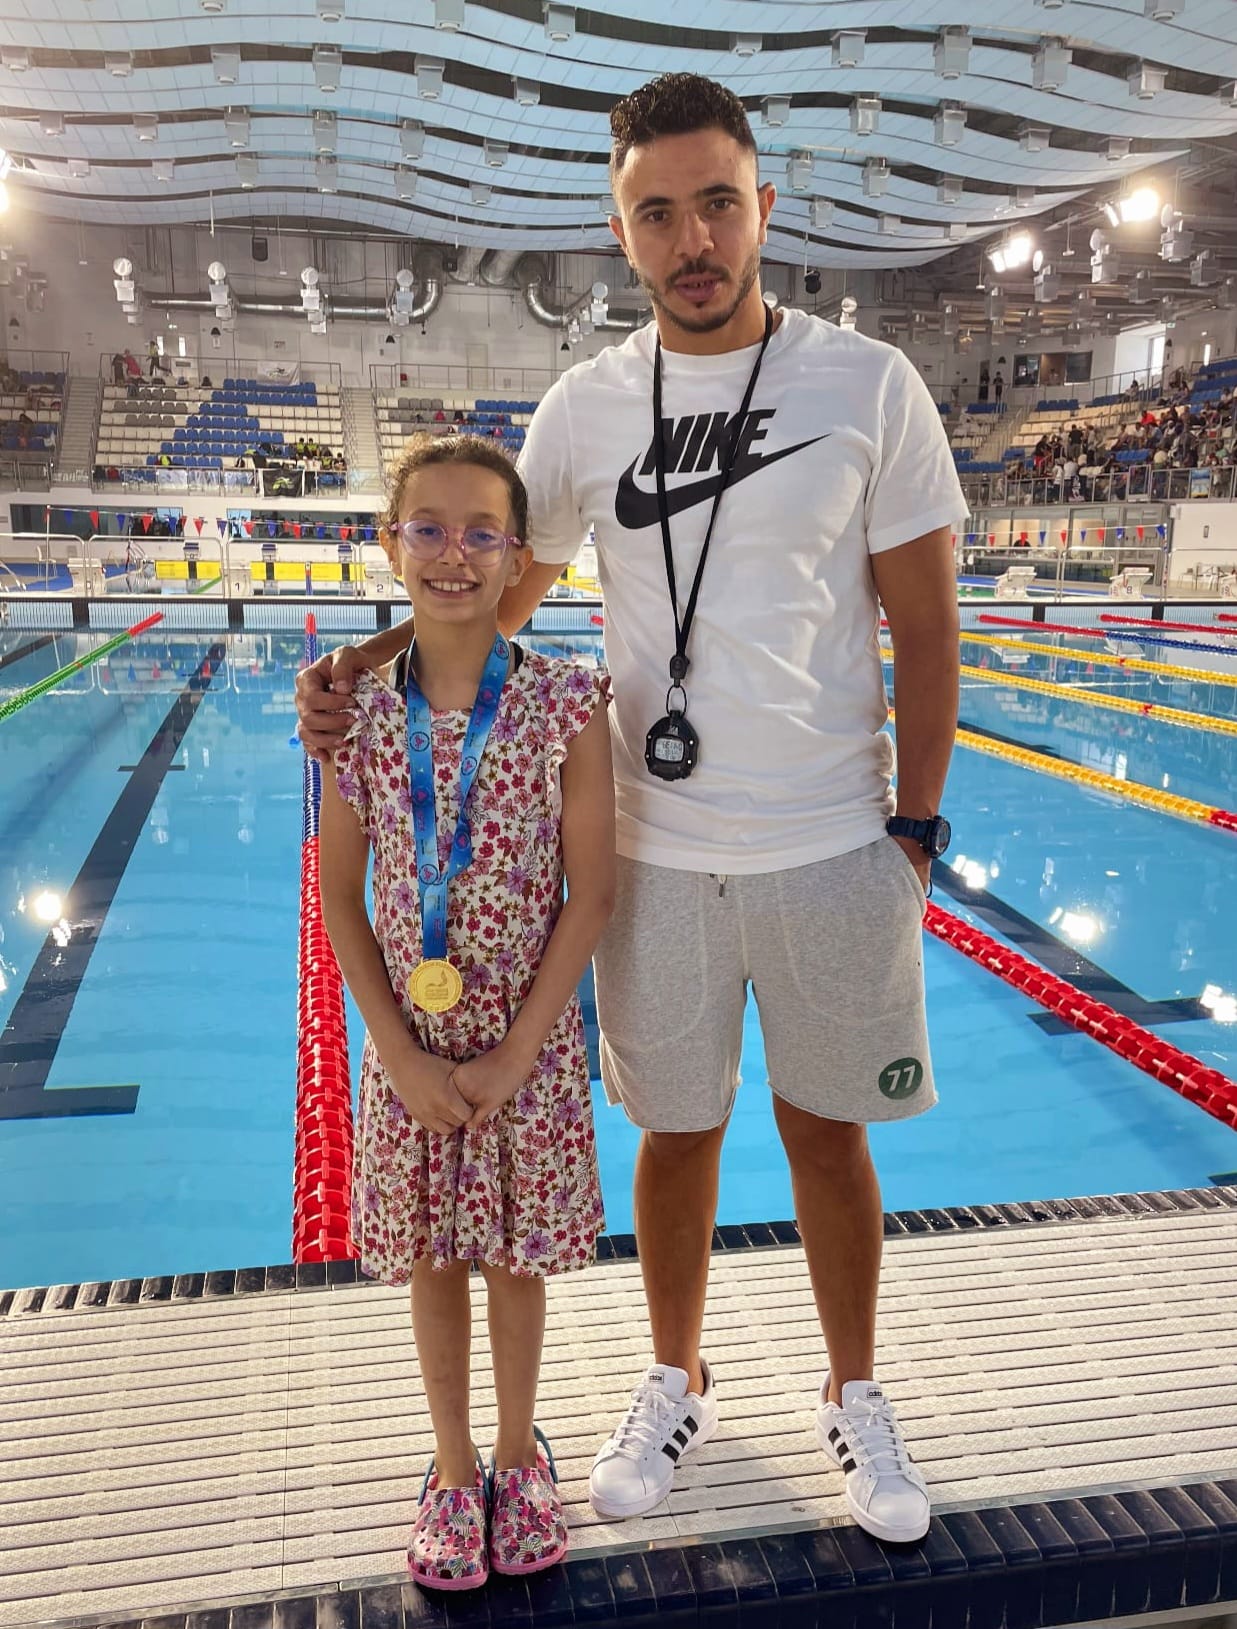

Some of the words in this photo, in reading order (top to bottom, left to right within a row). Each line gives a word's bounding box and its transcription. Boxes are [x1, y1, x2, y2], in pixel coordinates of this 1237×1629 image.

[638, 408, 777, 476] NIKE
[234, 582, 240, 591] 1
[376, 583, 384, 593] 2
[1126, 585, 1133, 594] 8
[887, 1064, 916, 1092] 77
